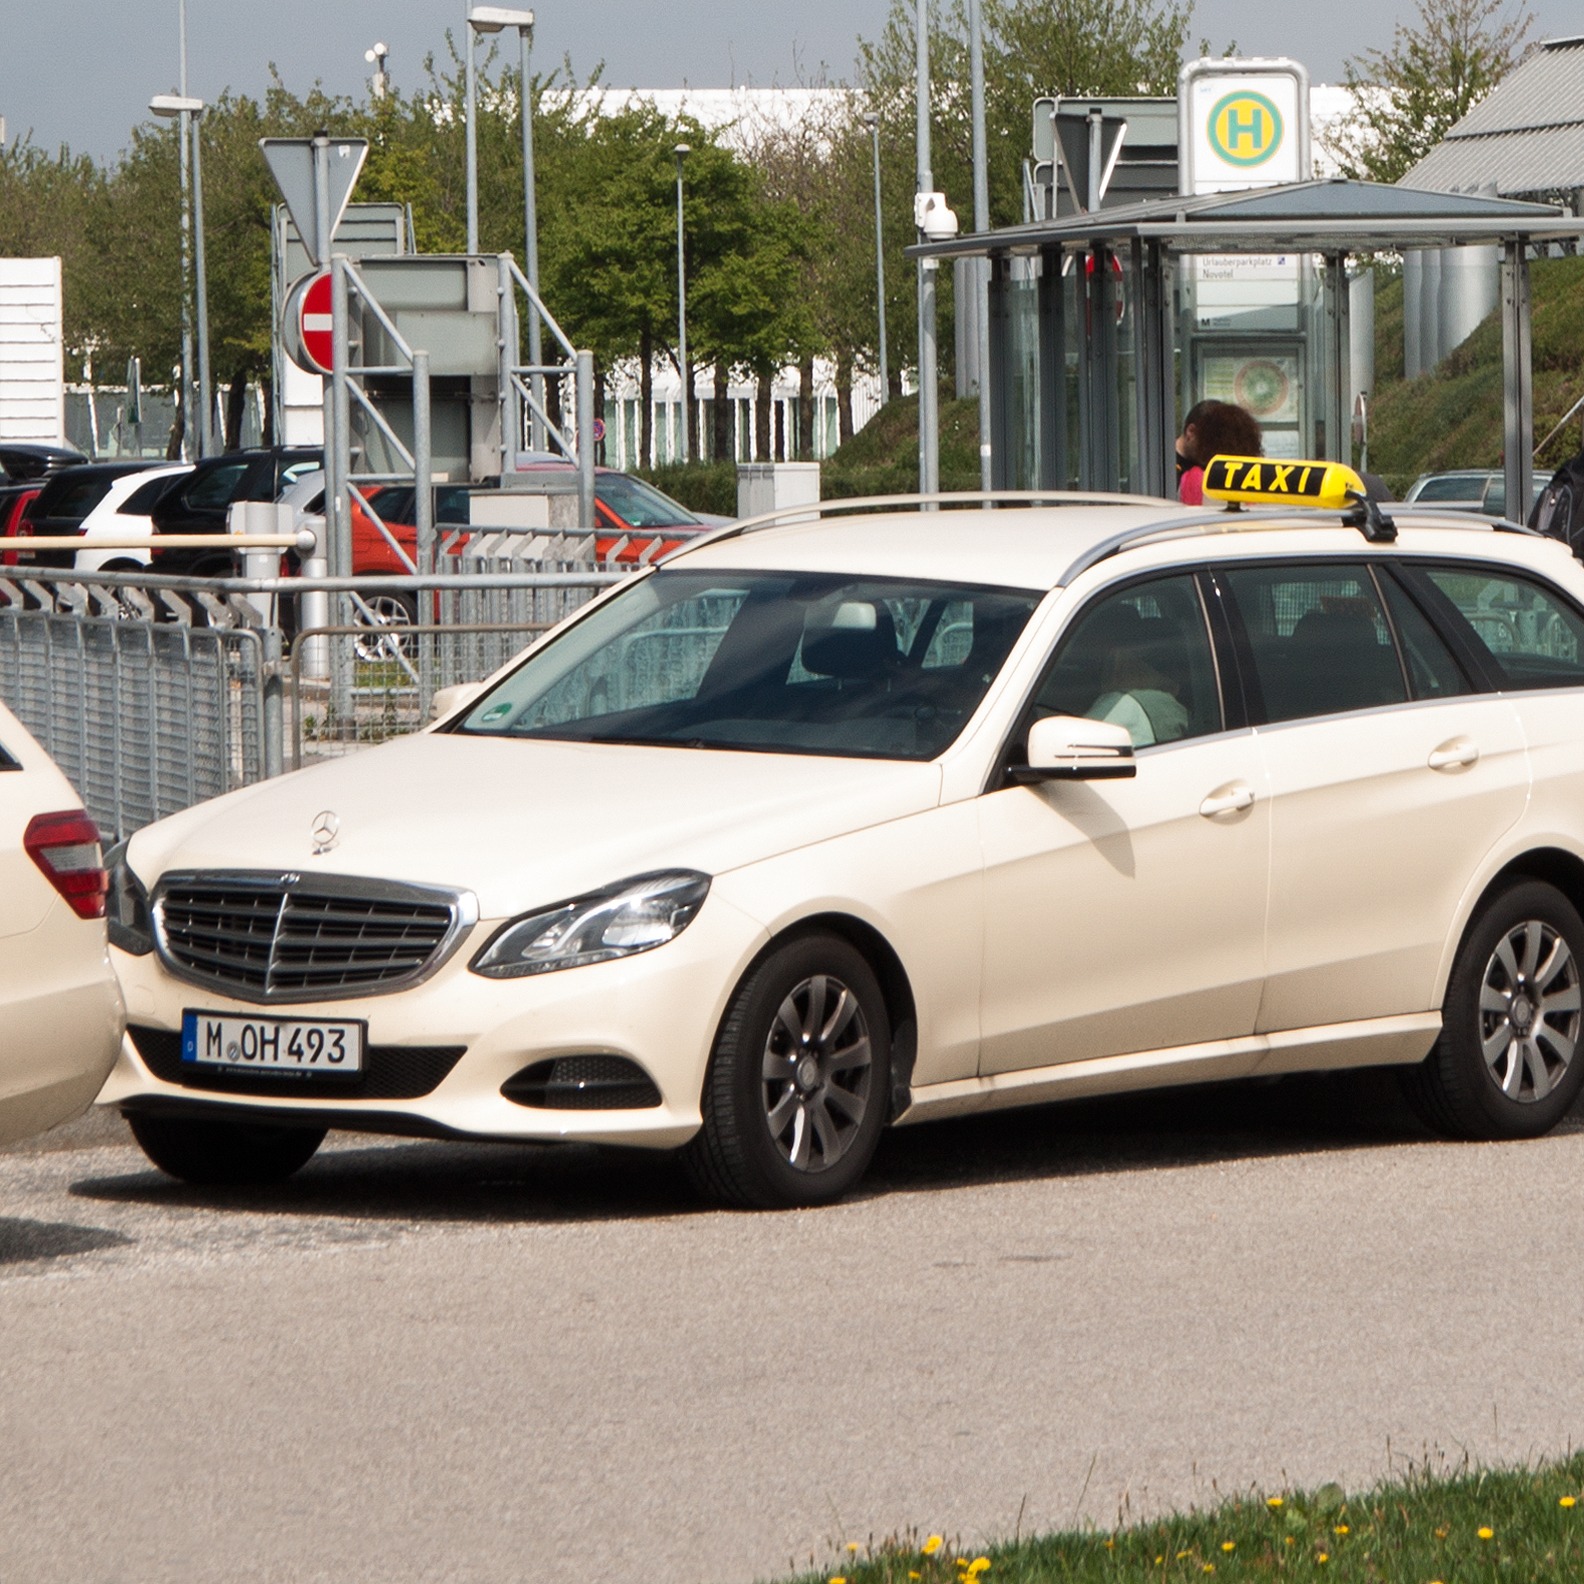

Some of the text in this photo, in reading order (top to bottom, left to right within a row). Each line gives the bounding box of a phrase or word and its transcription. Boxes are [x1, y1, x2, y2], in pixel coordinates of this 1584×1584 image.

[1228, 108, 1262, 149] H
[1203, 257, 1272, 268] Urlauberparkplatz
[1203, 269, 1233, 278] Novotel
[1224, 461, 1311, 493] TAXI
[206, 1021, 346, 1064] M OH 493
